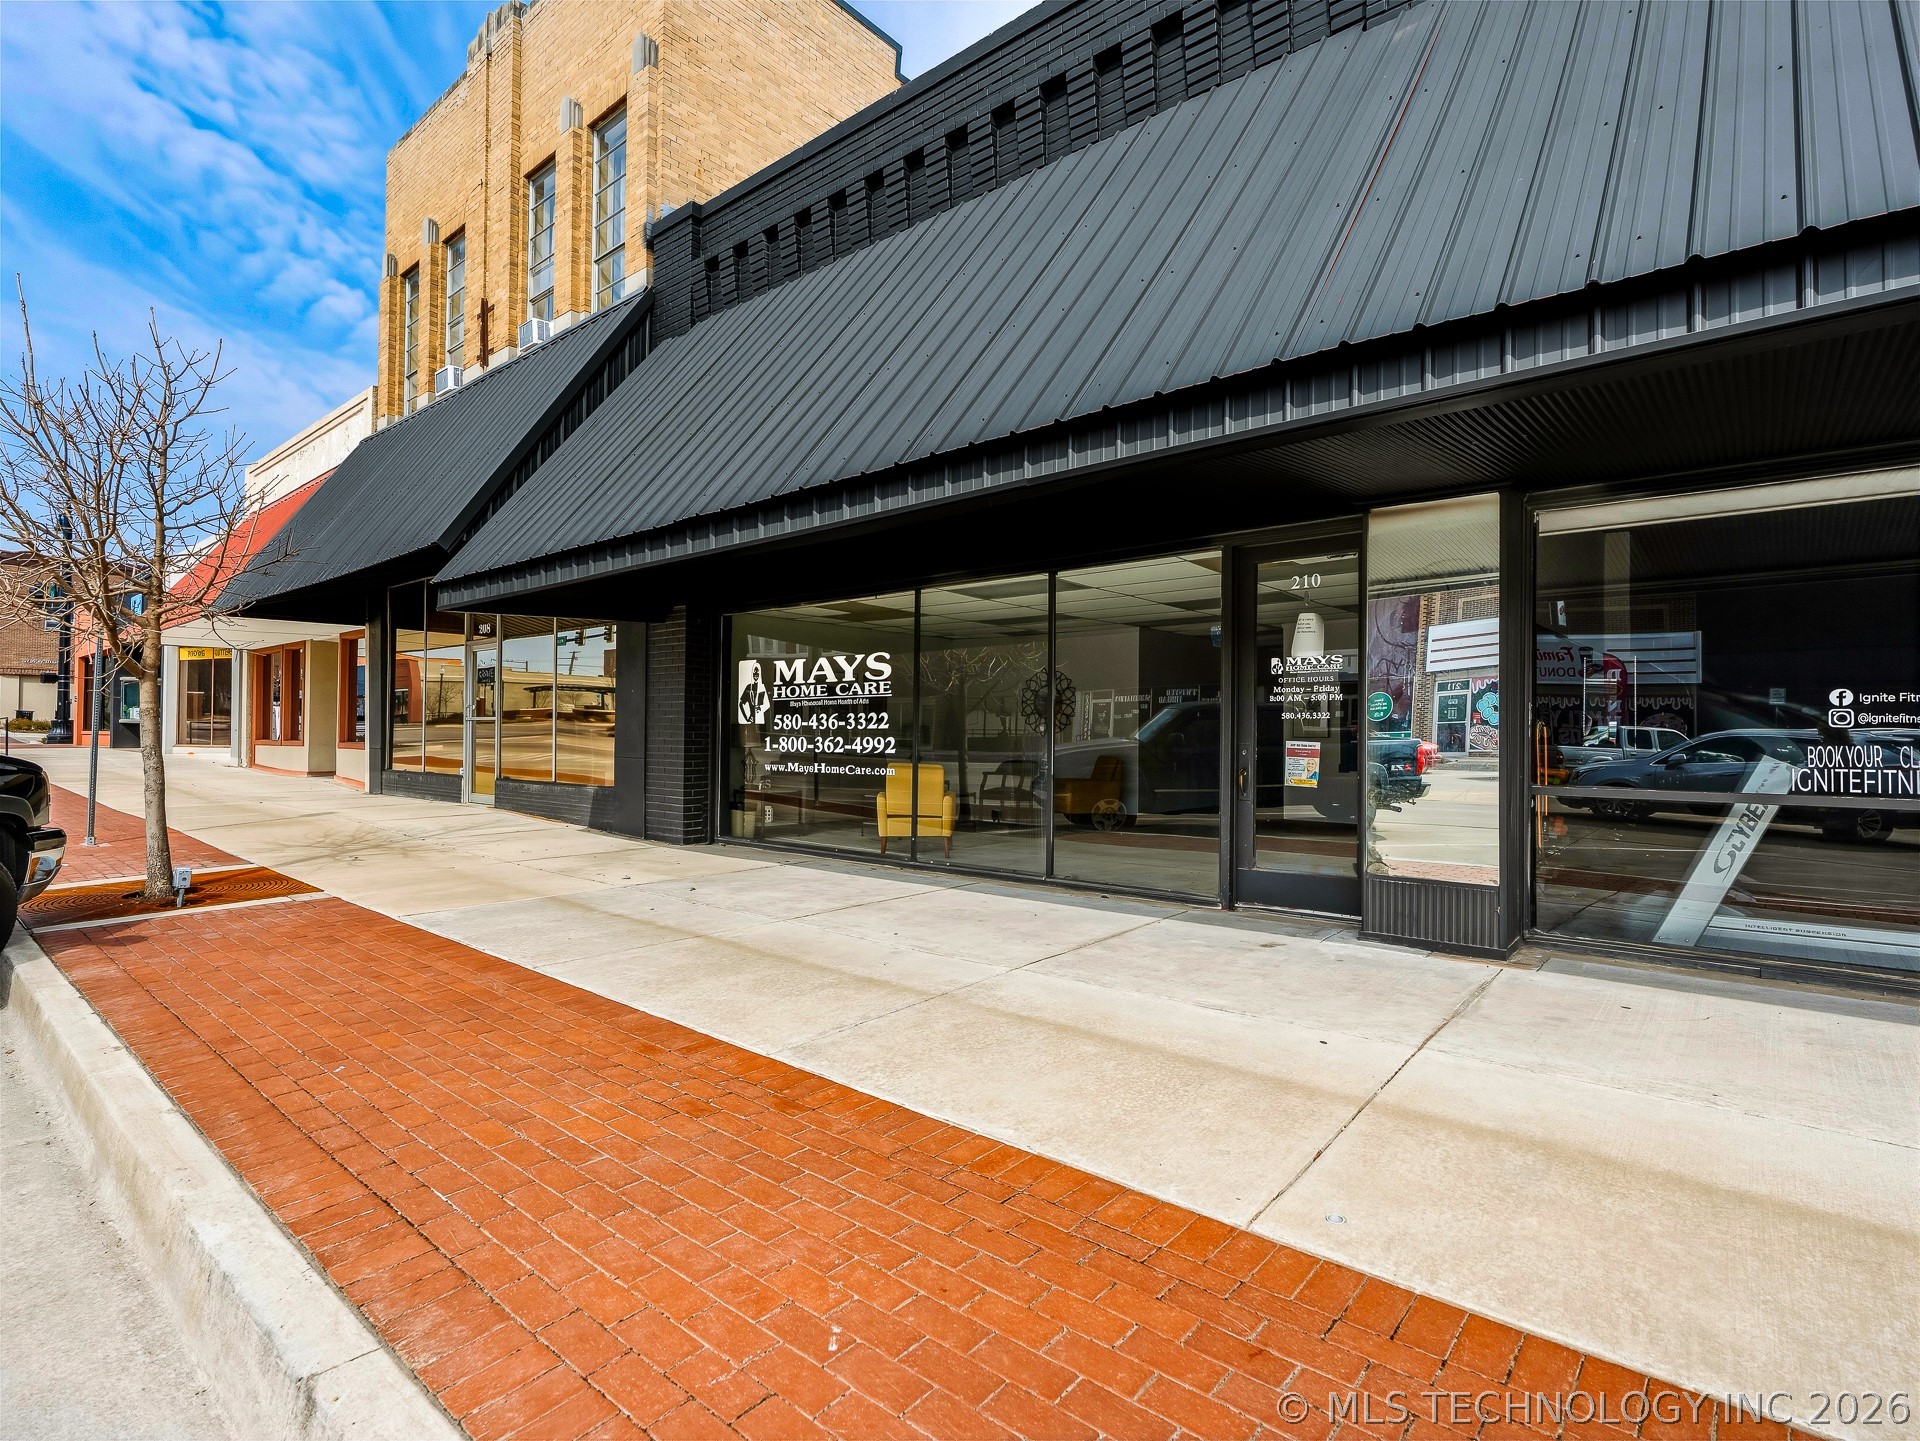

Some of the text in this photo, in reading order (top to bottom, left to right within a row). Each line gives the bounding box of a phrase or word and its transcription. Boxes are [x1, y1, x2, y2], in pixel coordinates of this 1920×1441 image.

[1291, 573, 1321, 589] 210
[1286, 654, 1343, 666] MAYS
[773, 652, 892, 685] MAYS
[772, 681, 892, 698] HOME CARE
[1310, 693, 1327, 701] 5:00
[1313, 685, 1340, 693] Friday
[1859, 692, 1896, 704] Ignite
[773, 712, 890, 730] 580-436-3322
[1281, 712, 1330, 720] 580.436.3322
[764, 736, 896, 754] 1-800-362-4992
[1807, 745, 1920, 768] BOOK YOUR CL
[764, 762, 895, 775] www.MaysHomeCare.com
[1791, 768, 1920, 794] IGNITEFITN
